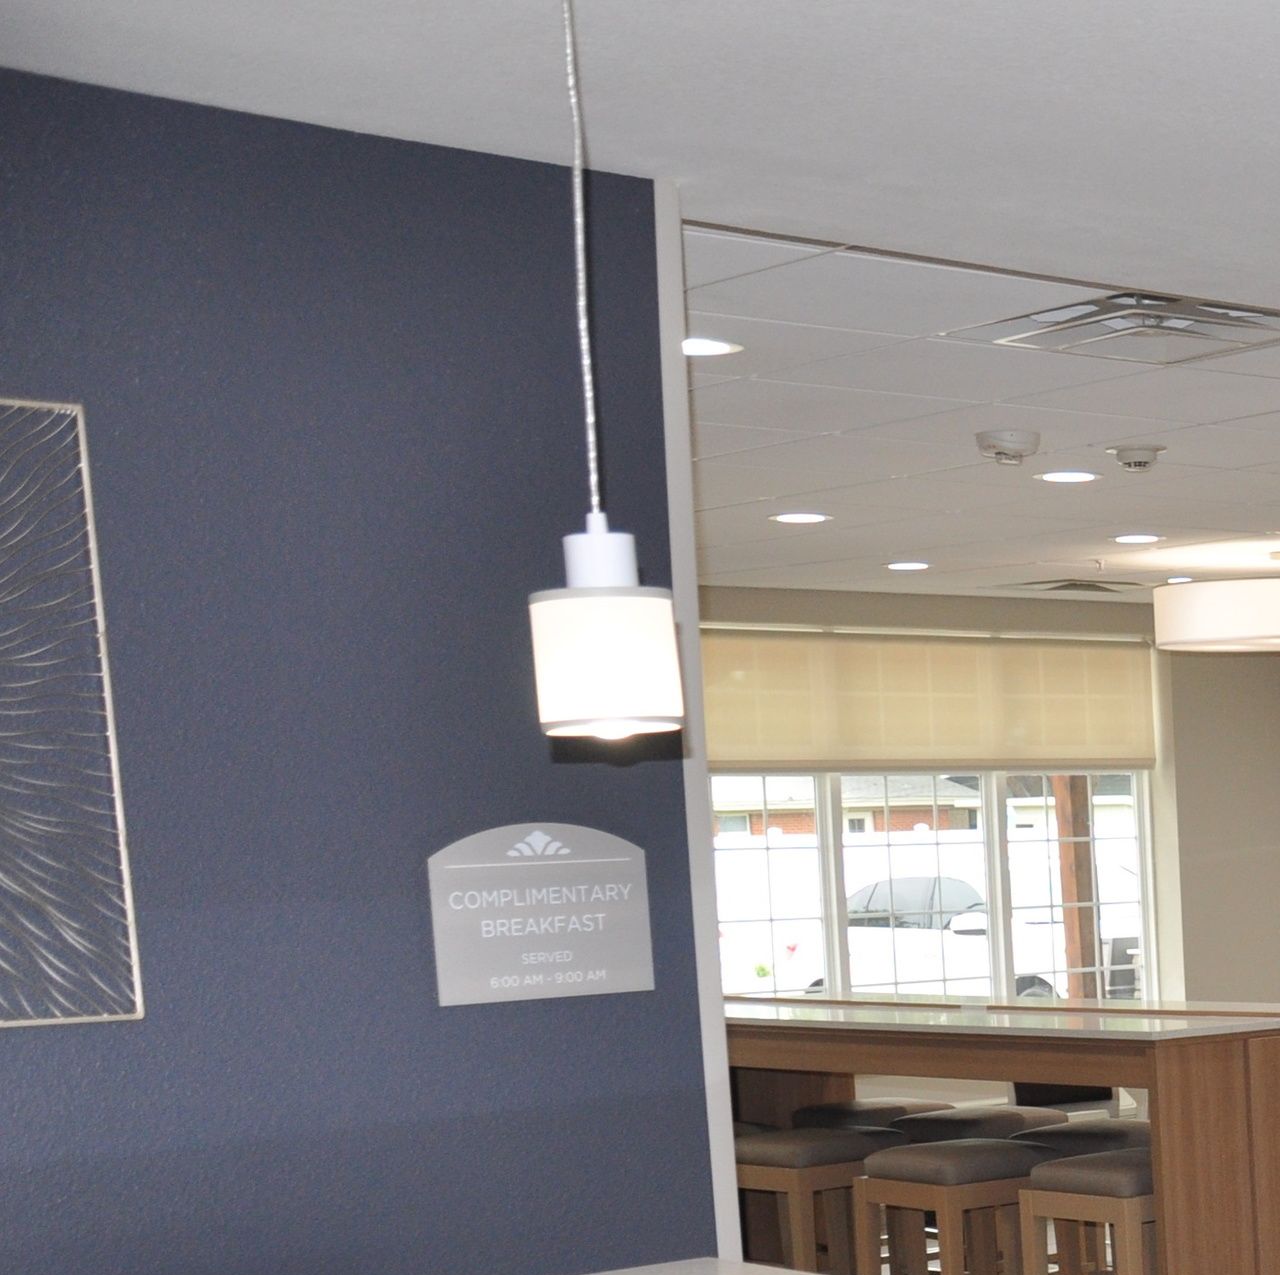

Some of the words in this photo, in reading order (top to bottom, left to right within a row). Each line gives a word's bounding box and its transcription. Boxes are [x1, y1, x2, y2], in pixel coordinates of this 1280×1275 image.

[449, 883, 632, 910] COMPLIMENTARY
[480, 913, 606, 938] BREAKFAST
[521, 950, 573, 965] SERVED
[523, 973, 544, 985] AM
[585, 969, 606, 981] AM
